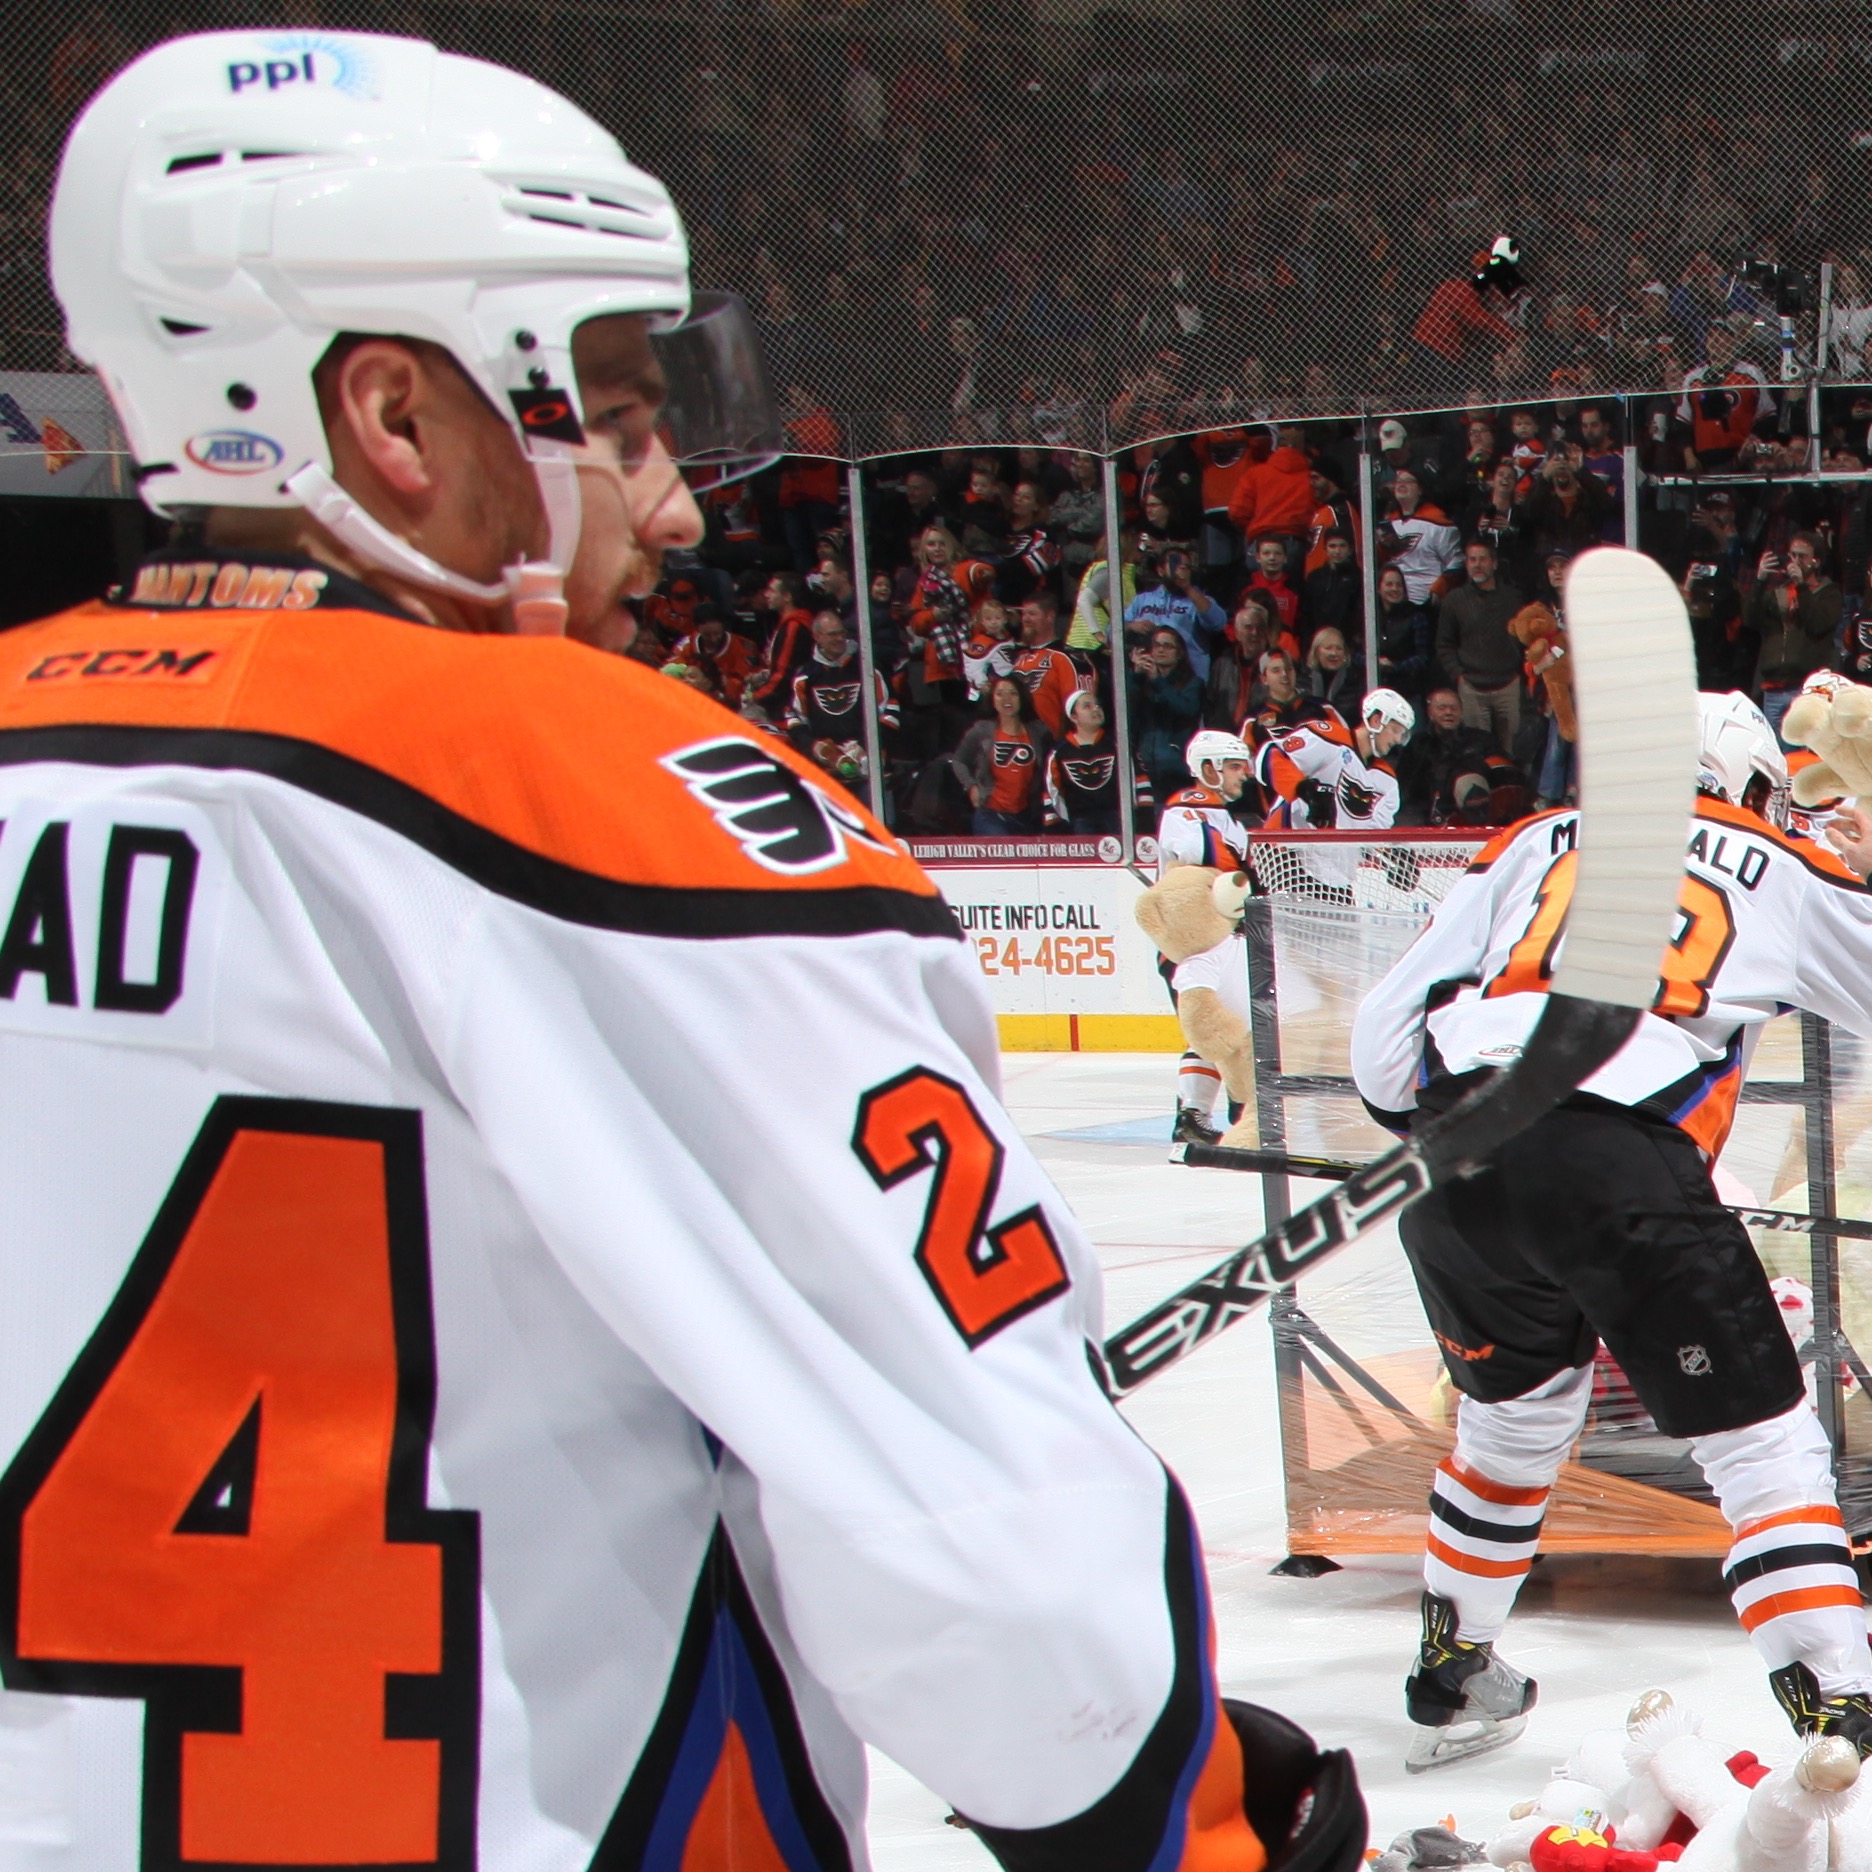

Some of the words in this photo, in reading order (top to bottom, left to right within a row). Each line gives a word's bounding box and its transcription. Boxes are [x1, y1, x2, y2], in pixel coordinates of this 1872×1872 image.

[228, 53, 314, 93] ppl
[203, 440, 264, 462] AHL
[26, 649, 217, 681] CCM
[914, 844, 945, 858] LEHIGH
[948, 844, 986, 858] VALLEY'S
[988, 844, 1014, 858] CLEAR
[1017, 844, 1048, 858] CHOICE
[1050, 844, 1065, 858] FOR
[1067, 843, 1094, 857] GLASS
[0, 820, 201, 1014] AD
[1005, 905, 1048, 930] INFO
[1053, 905, 1100, 930] CALL
[972, 936, 1116, 976] 24-4625
